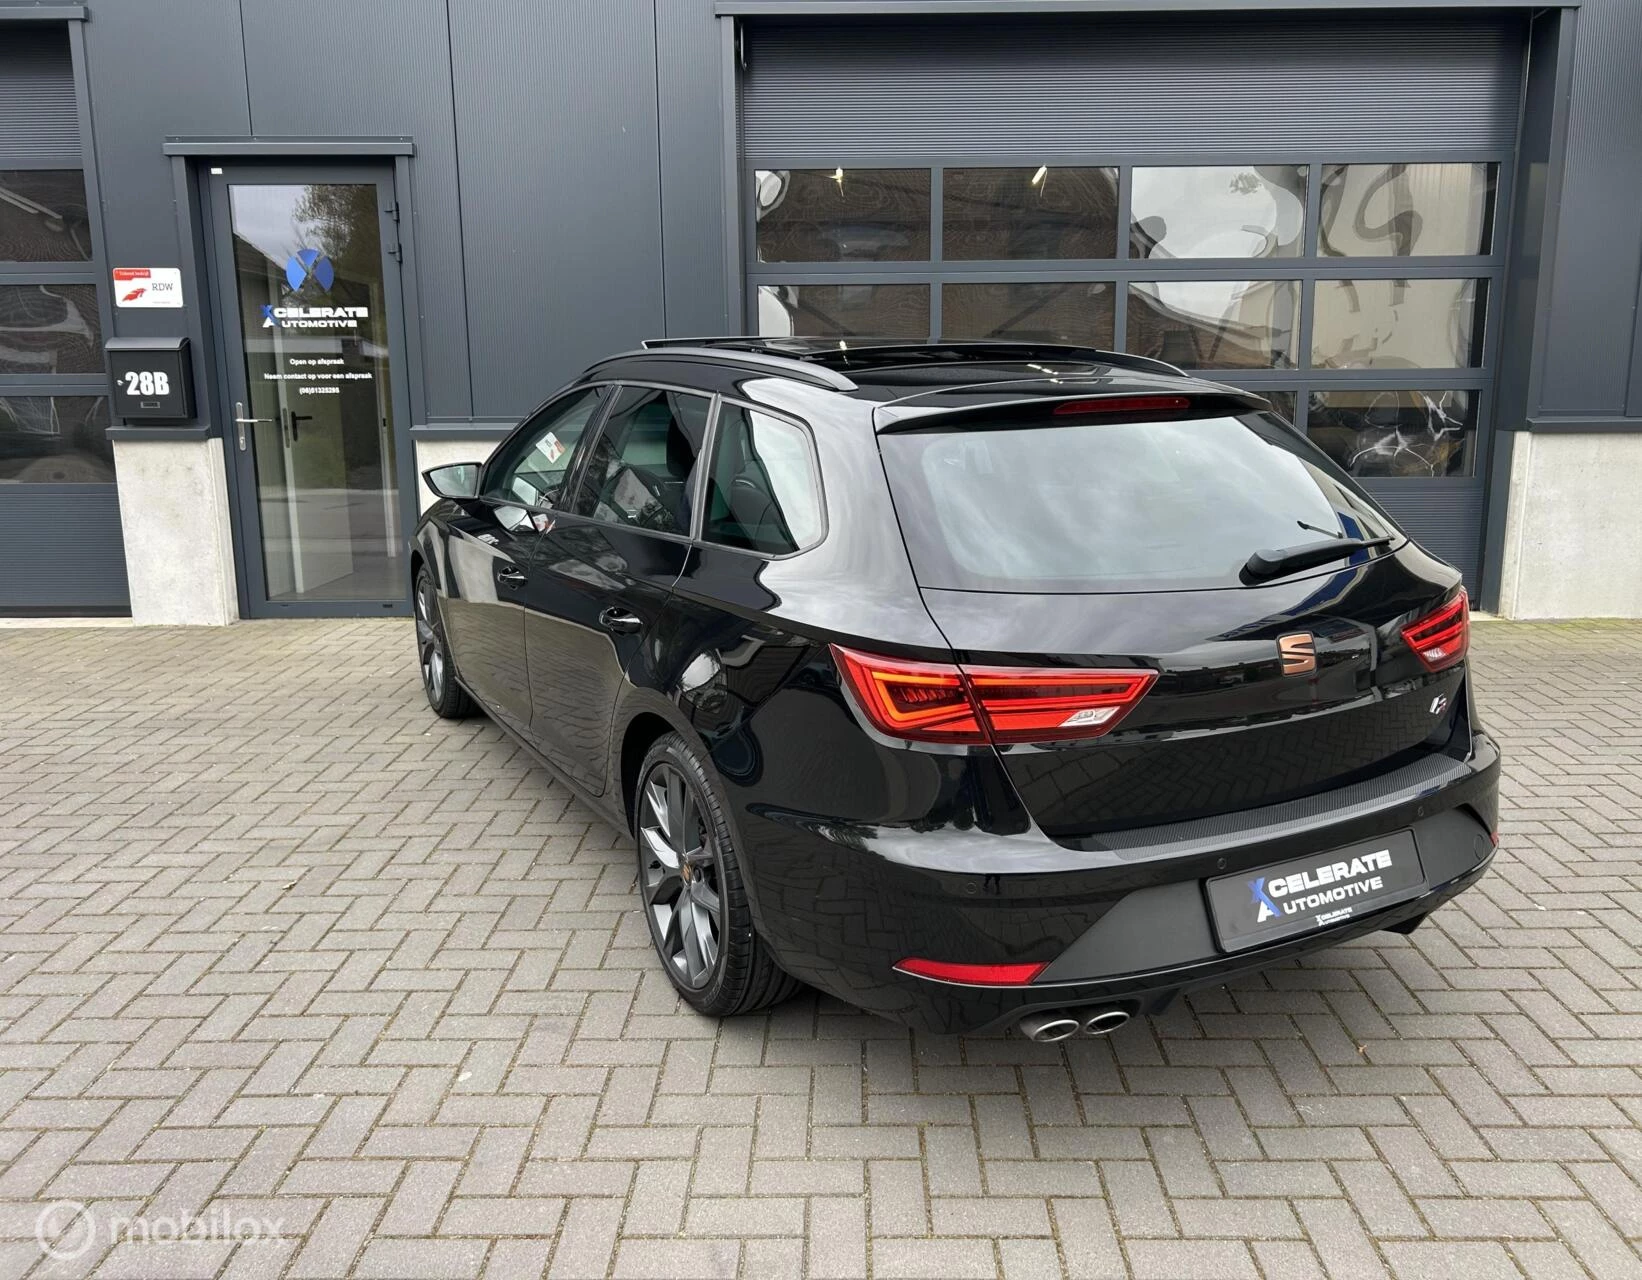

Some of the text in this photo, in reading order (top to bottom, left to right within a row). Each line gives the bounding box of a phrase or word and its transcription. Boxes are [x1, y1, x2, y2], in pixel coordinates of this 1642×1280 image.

[152, 283, 173, 291] RDW
[261, 305, 368, 321] XCELERATE
[262, 318, 357, 328] AUTOMOTIVE
[289, 358, 307, 366] Open
[125, 371, 169, 395] 28B
[1248, 849, 1392, 908] XCELERATE
[1257, 876, 1384, 923] AUTOMOTIVE
